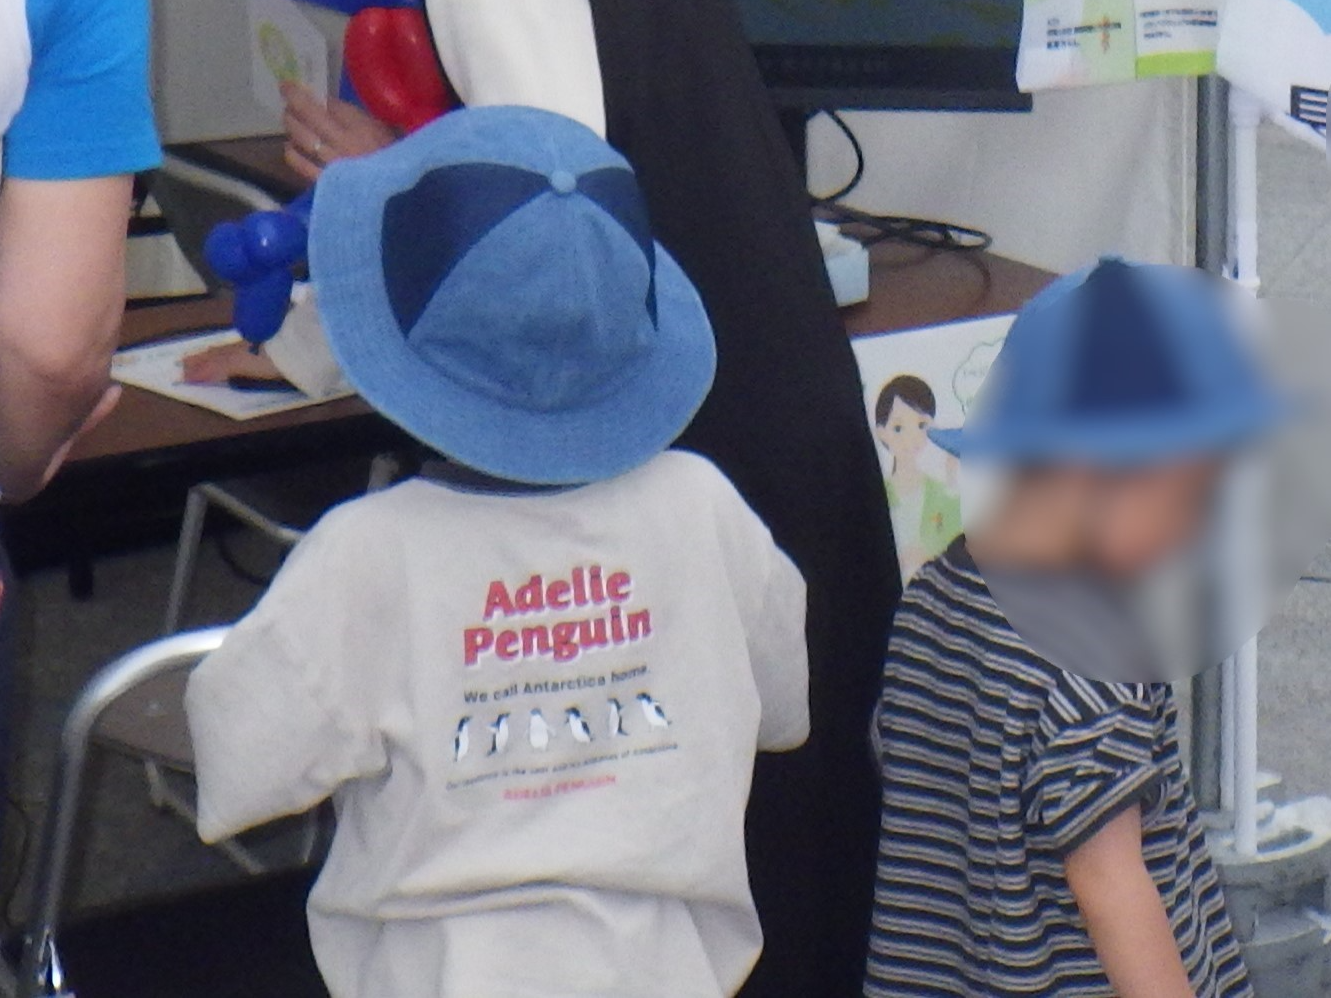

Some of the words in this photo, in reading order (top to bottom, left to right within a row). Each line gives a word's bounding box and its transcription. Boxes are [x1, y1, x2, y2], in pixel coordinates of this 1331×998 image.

[483, 563, 631, 620] Adelie
[464, 606, 651, 666] Penguin
[464, 689, 488, 704] We
[493, 684, 518, 701] call
[523, 674, 606, 696] Antarctica
